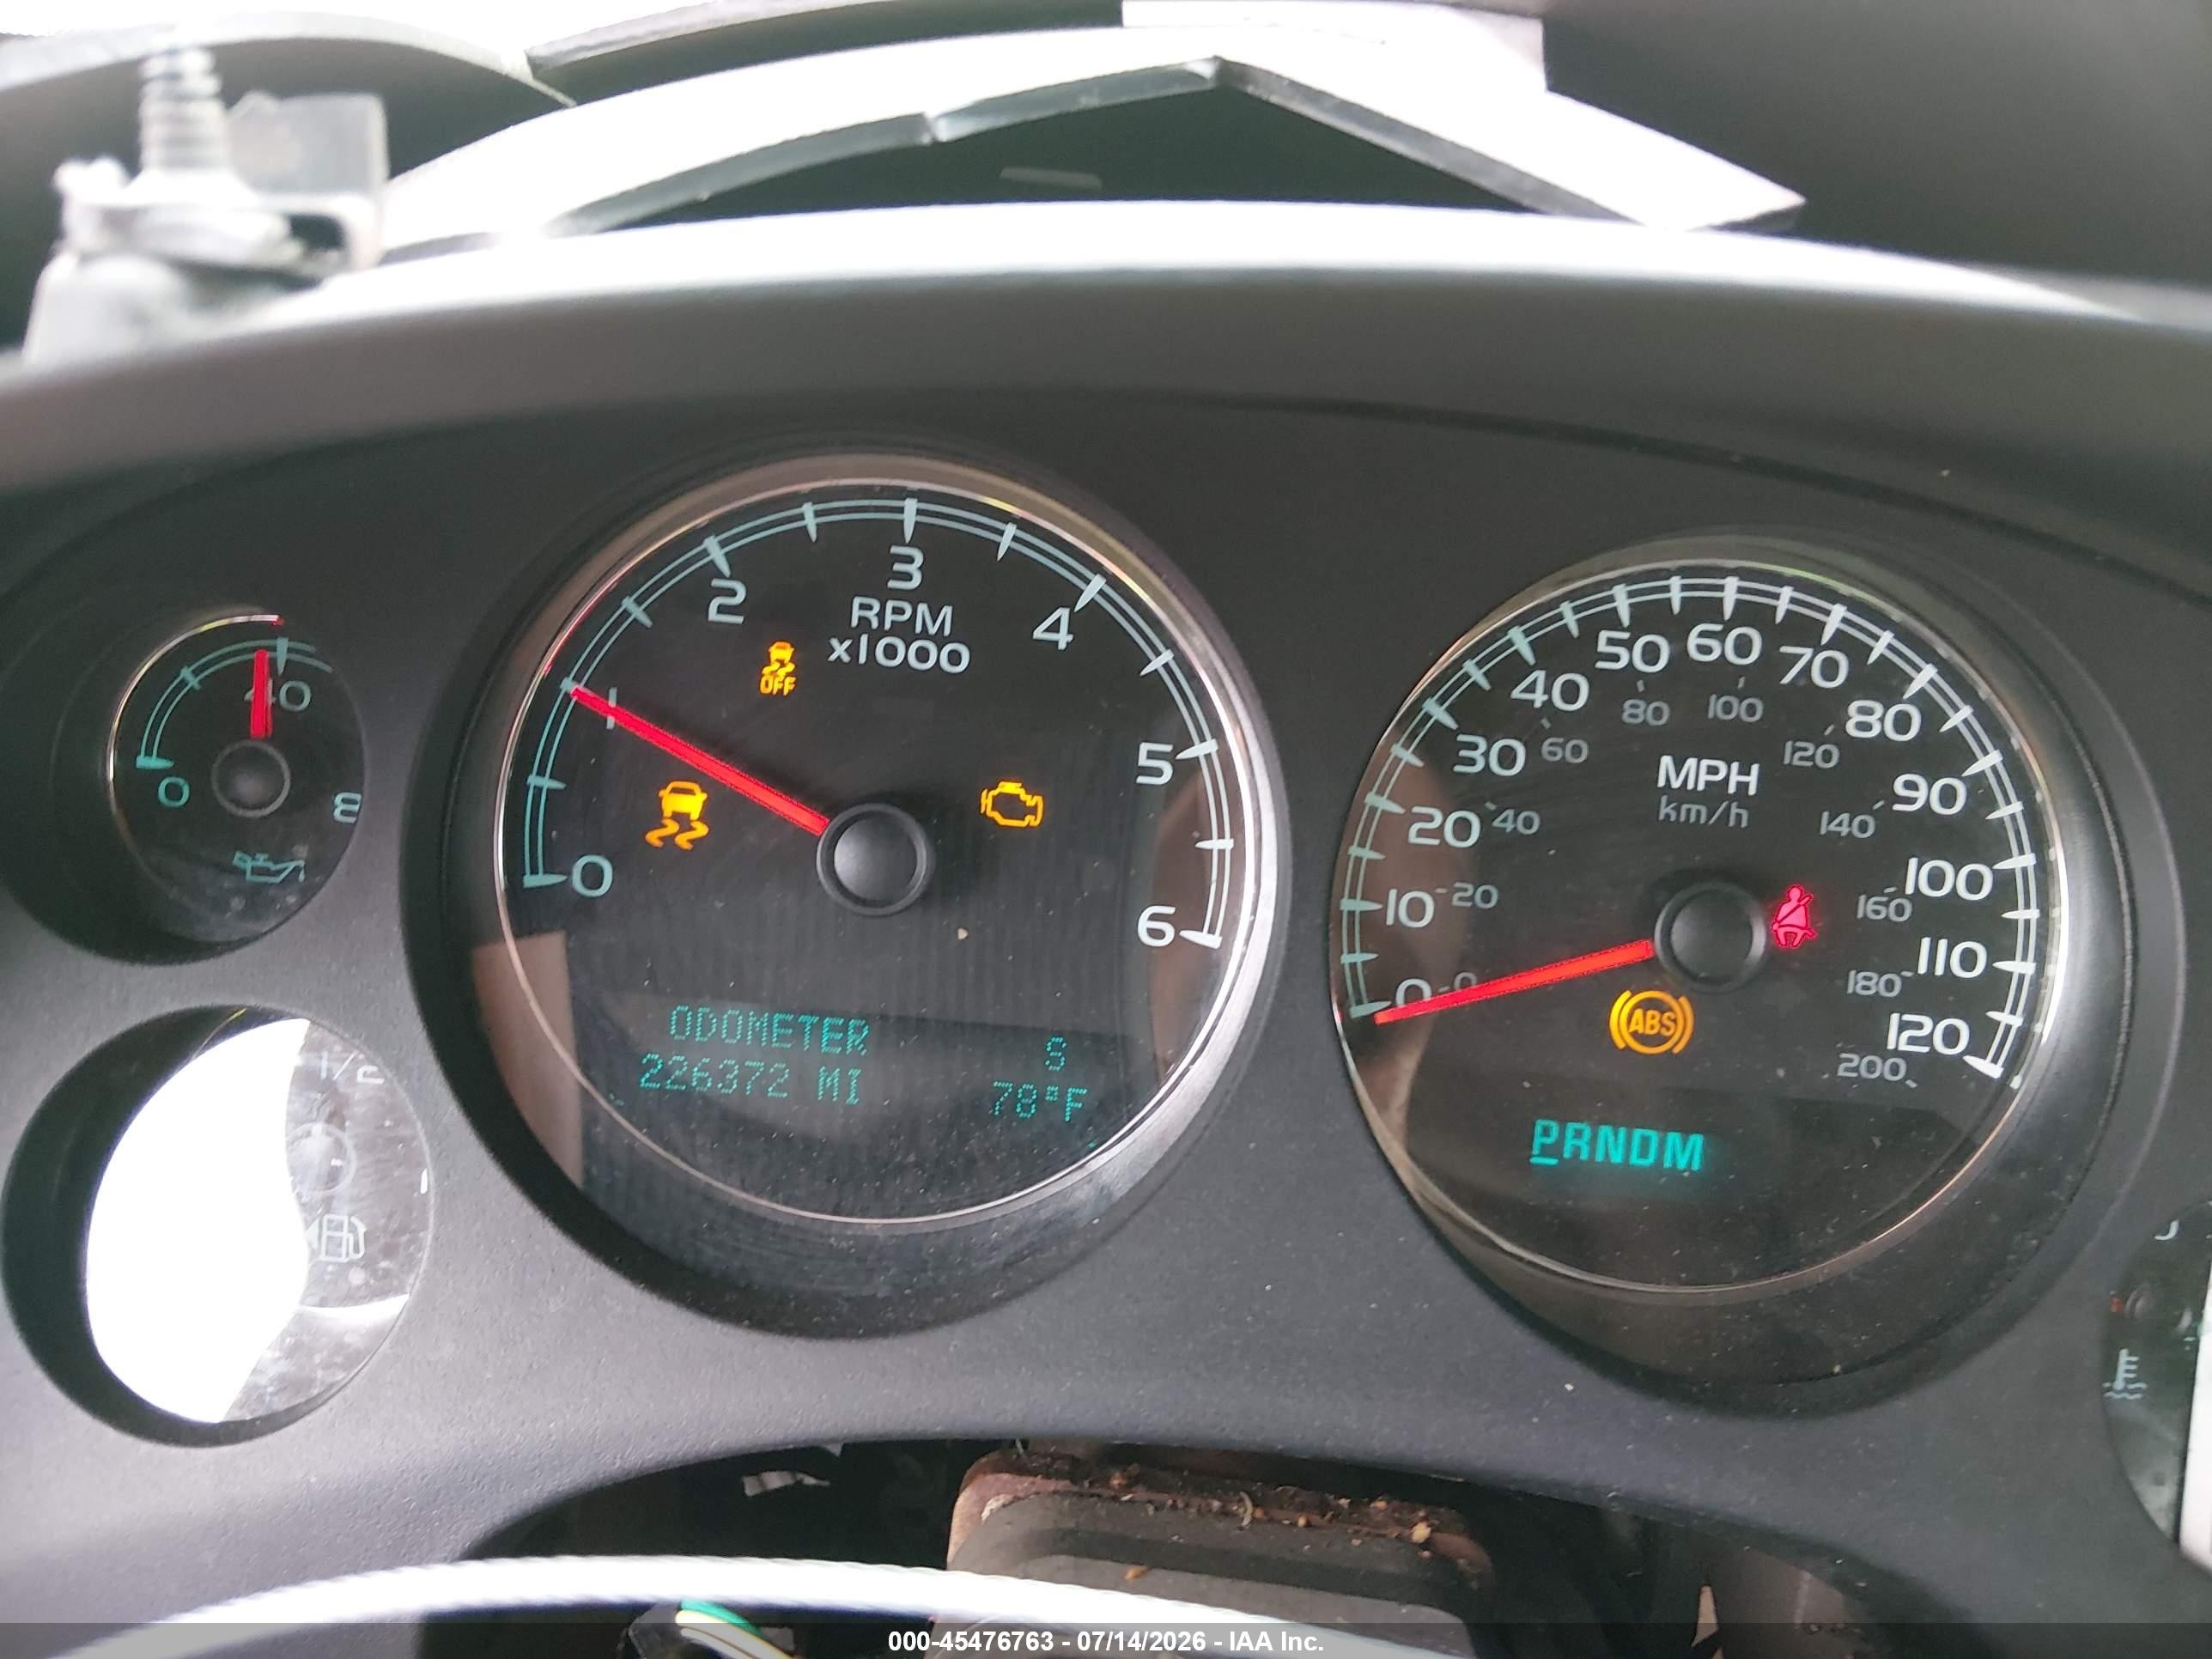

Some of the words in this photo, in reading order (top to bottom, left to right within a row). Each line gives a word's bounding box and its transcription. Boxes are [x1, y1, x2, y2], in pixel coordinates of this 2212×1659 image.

[888, 545, 924, 590] 3
[708, 578, 746, 624] 2
[850, 596, 953, 636] RPM
[1032, 606, 1074, 651] 4
[1686, 623, 1762, 665] 60
[1595, 629, 1670, 673] 50
[1778, 645, 1849, 689] 70
[759, 677, 797, 696] OFF
[1510, 669, 1589, 712] 40
[1621, 699, 1670, 726] 80
[1707, 694, 1764, 723] 100
[1844, 699, 1921, 741] 80
[1135, 742, 1174, 785] 5
[1453, 734, 1527, 776] 30
[1540, 739, 1589, 763] 60
[1783, 740, 1840, 769] 120
[157, 776, 190, 807] 0
[1656, 755, 1760, 797] MPH
[1892, 774, 1967, 815] 90
[1407, 805, 1481, 848] 20
[1492, 809, 1540, 836] 40
[1658, 794, 1750, 829] km/h
[1819, 811, 1876, 838] 140
[571, 854, 613, 897] 0
[1451, 882, 1499, 908] 20
[1905, 857, 1994, 901] 100
[1136, 905, 1176, 947] 6
[1385, 889, 1435, 928] 10
[1856, 894, 1913, 922] 160
[1917, 936, 1988, 979] 110
[1847, 969, 1903, 998] 180
[670, 1005, 870, 1056] ODOMETER
[1628, 1008, 1678, 1037] ABS
[1886, 1012, 1971, 1055] 120
[1045, 1036, 1067, 1072] S
[1837, 1053, 1907, 1082] 200
[640, 1053, 789, 1099] 226372
[817, 1065, 861, 1105] MI
[1530, 1118, 1705, 1171] PRNDM
